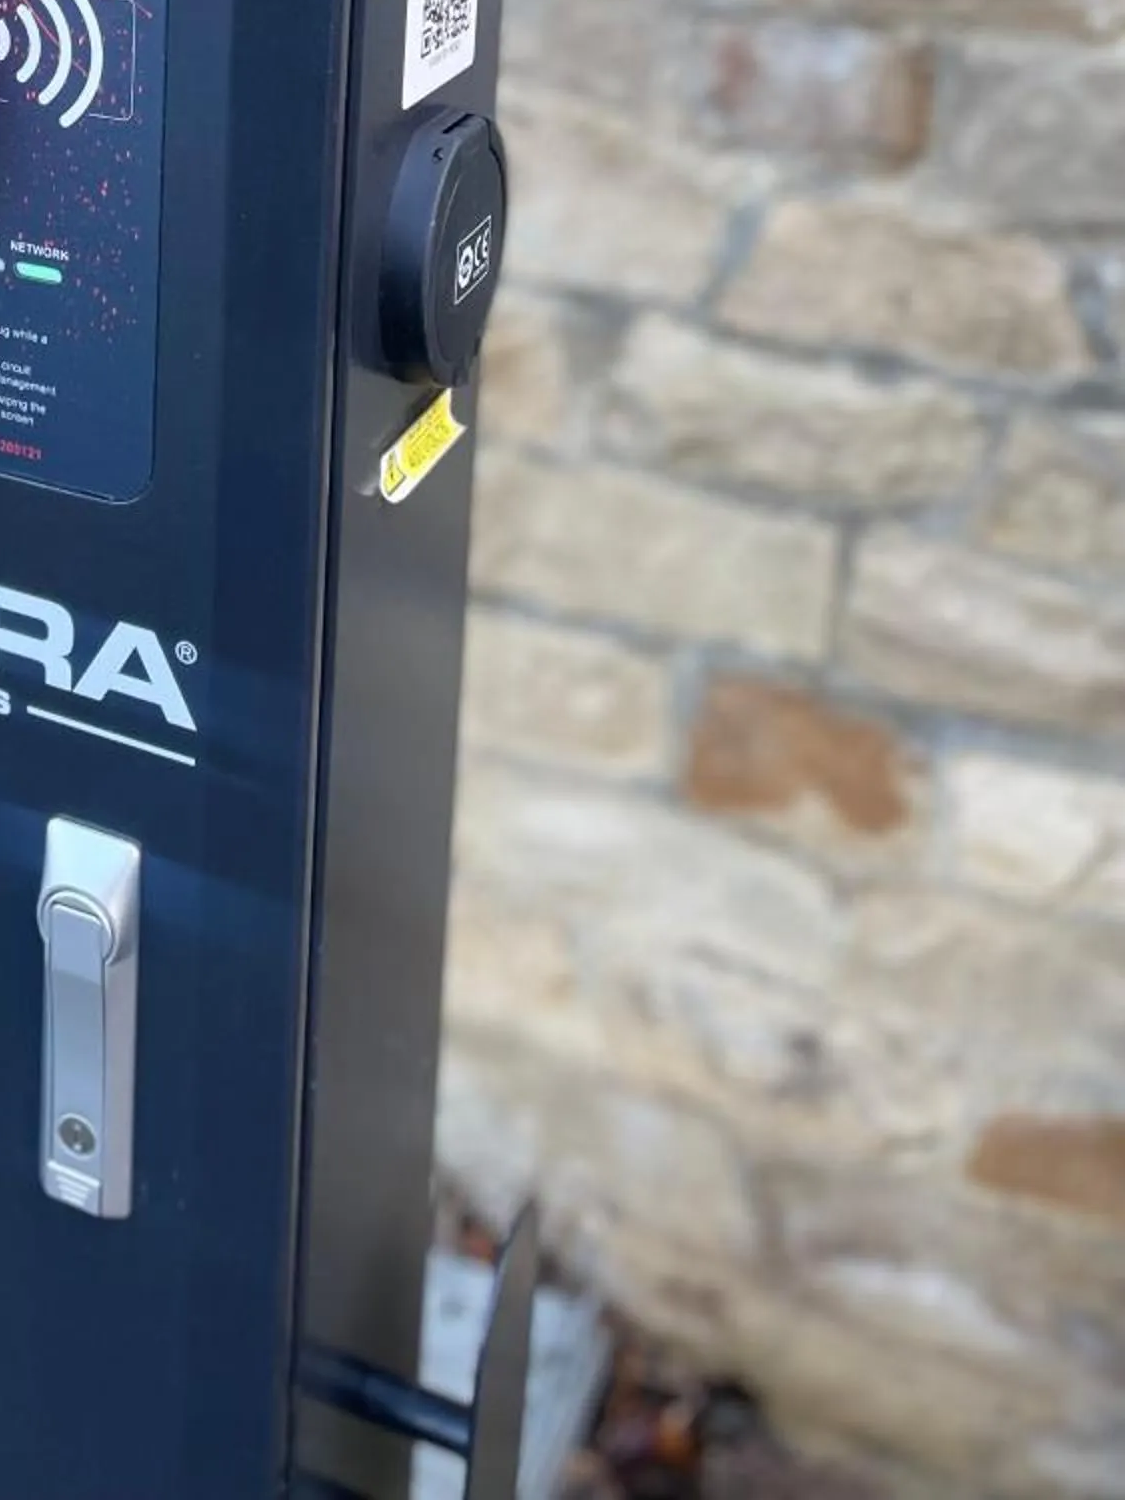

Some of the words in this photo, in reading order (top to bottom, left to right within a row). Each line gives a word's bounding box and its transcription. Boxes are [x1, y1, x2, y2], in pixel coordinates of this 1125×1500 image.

[10, 239, 70, 262] NETWORK
[12, 328, 38, 343] while
[40, 335, 48, 346] a
[0, 360, 32, 377] circuit
[30, 400, 47, 416] the
[0, 409, 34, 427] screen
